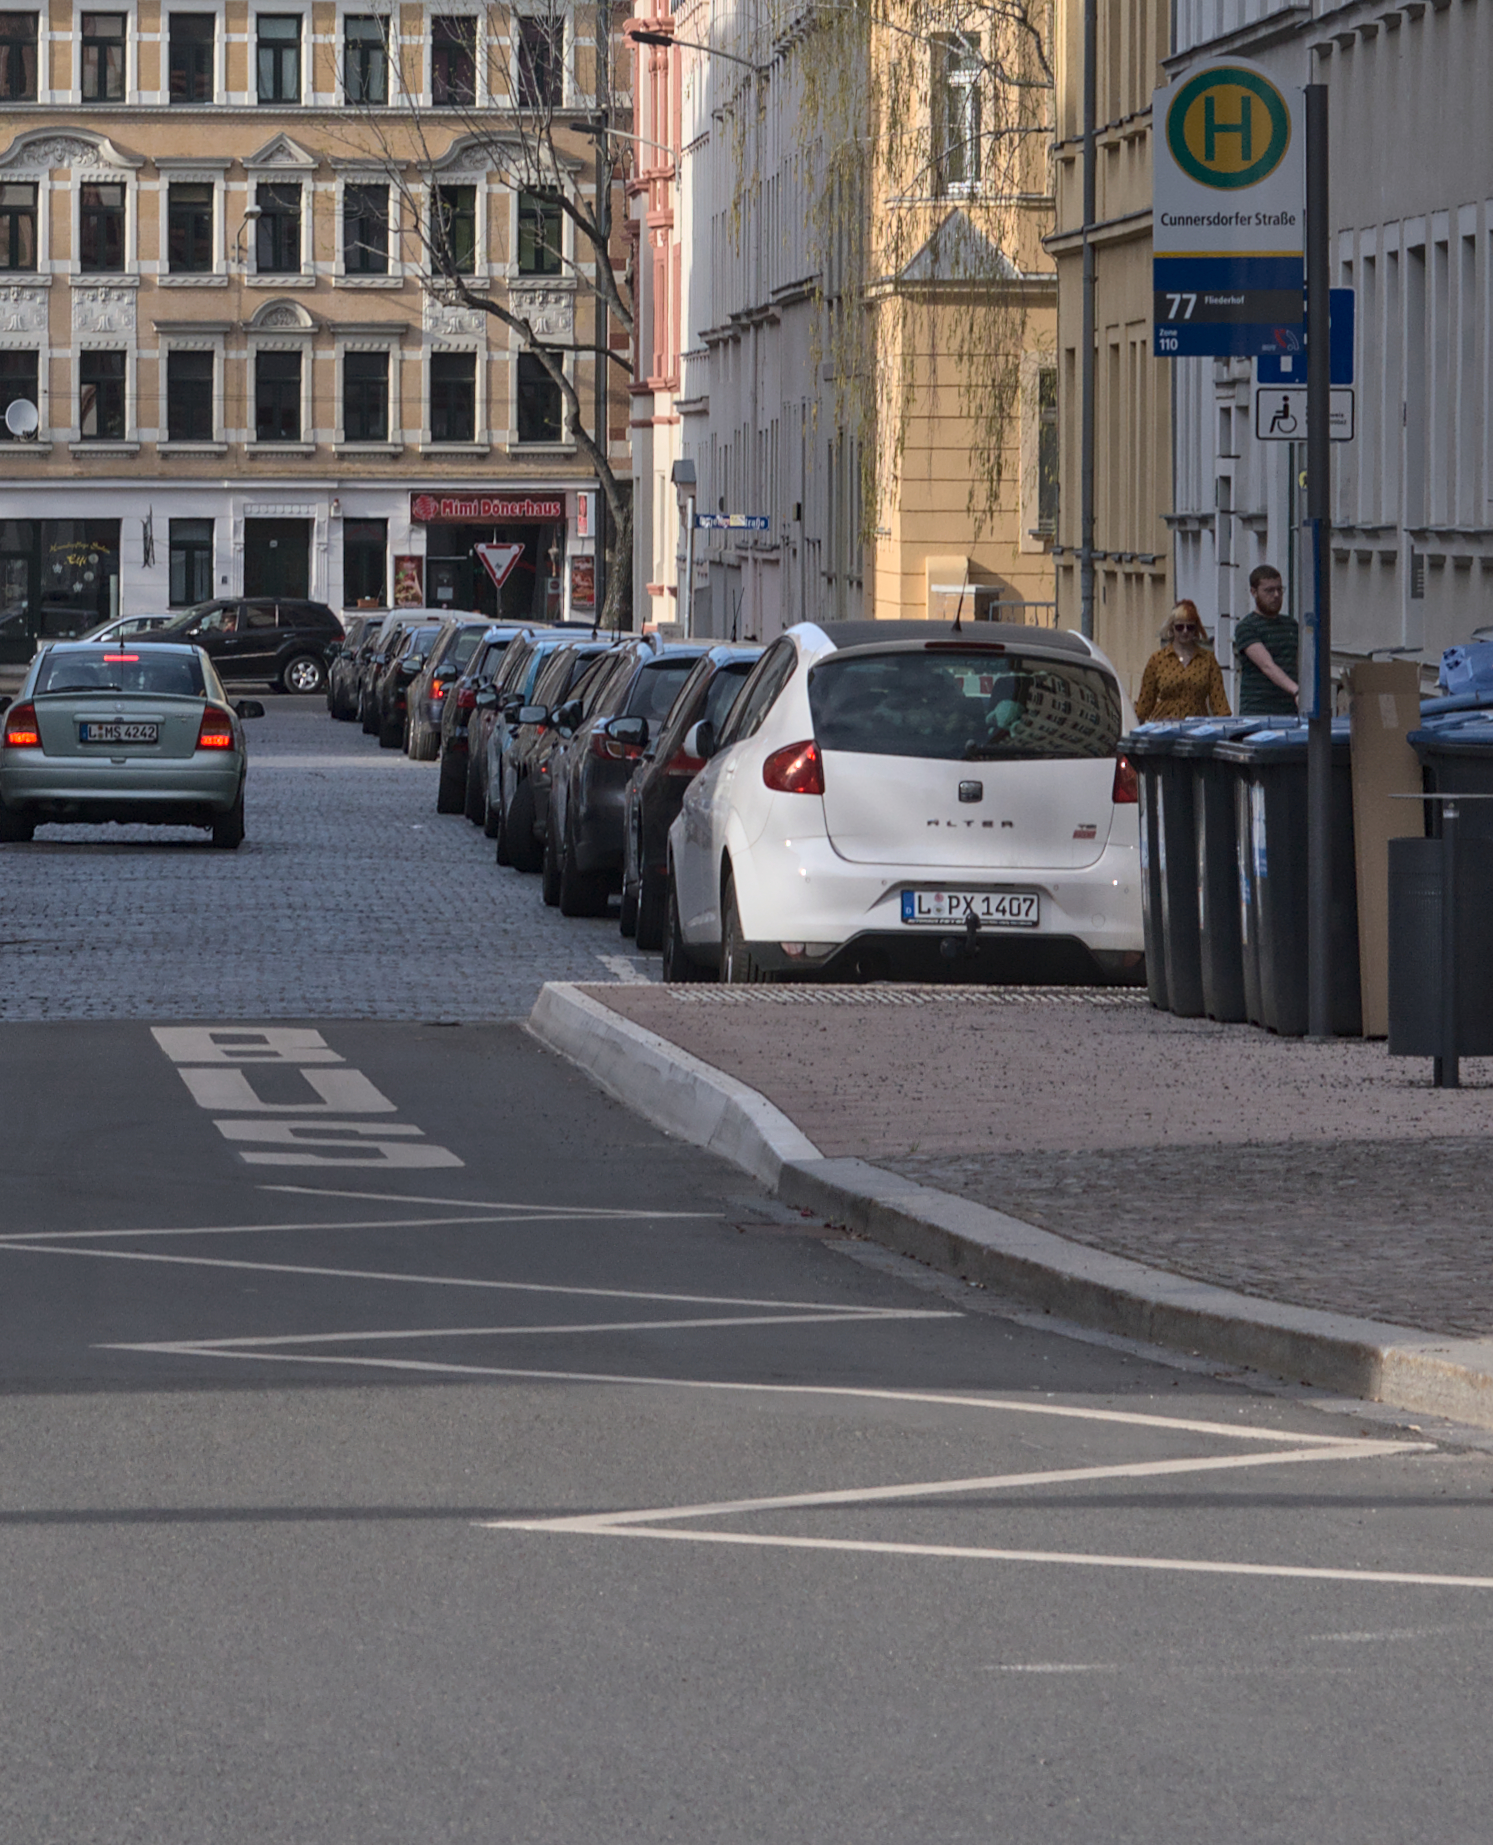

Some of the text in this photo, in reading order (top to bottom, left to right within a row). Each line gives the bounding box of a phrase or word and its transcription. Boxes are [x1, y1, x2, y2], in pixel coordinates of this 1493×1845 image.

[1204, 95, 1251, 161] H
[1160, 211, 1296, 226] Cunnersdorfer Straße
[1166, 293, 1245, 320] 77 Fliederhof
[1159, 328, 1178, 337] Zone
[1159, 338, 1179, 351] 110
[441, 499, 561, 516] Mimi Dönerhaus
[88, 726, 155, 738] L MS 4242
[918, 895, 931, 915] L
[947, 895, 975, 916] PX
[981, 896, 1035, 918] 1407
[150, 1026, 465, 1167] BUS
